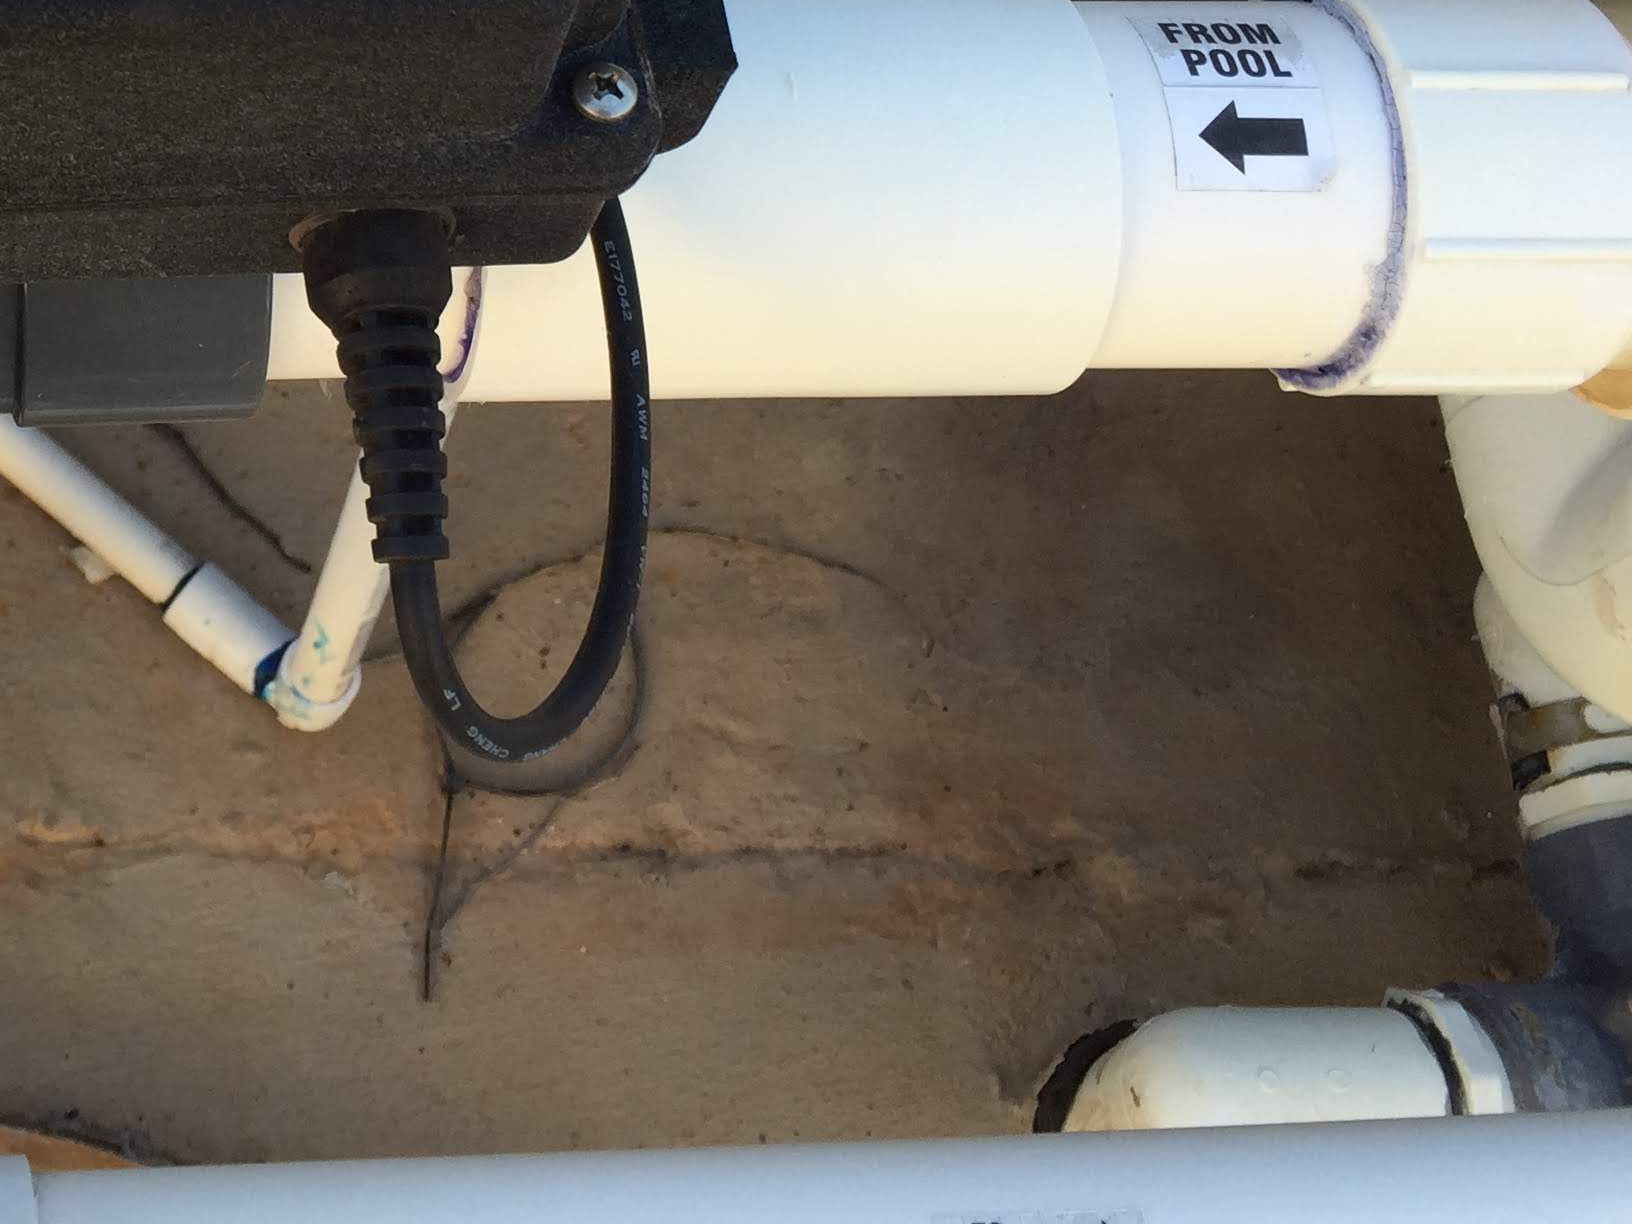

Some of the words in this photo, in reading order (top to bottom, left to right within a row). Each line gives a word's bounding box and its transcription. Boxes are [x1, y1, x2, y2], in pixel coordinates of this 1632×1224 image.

[1157, 23, 1281, 44] FROM
[1180, 49, 1293, 77] POOL
[604, 239, 632, 322] E177042
[634, 392, 648, 441] AWM
[442, 688, 461, 711] LF
[467, 725, 510, 759] CHENG
